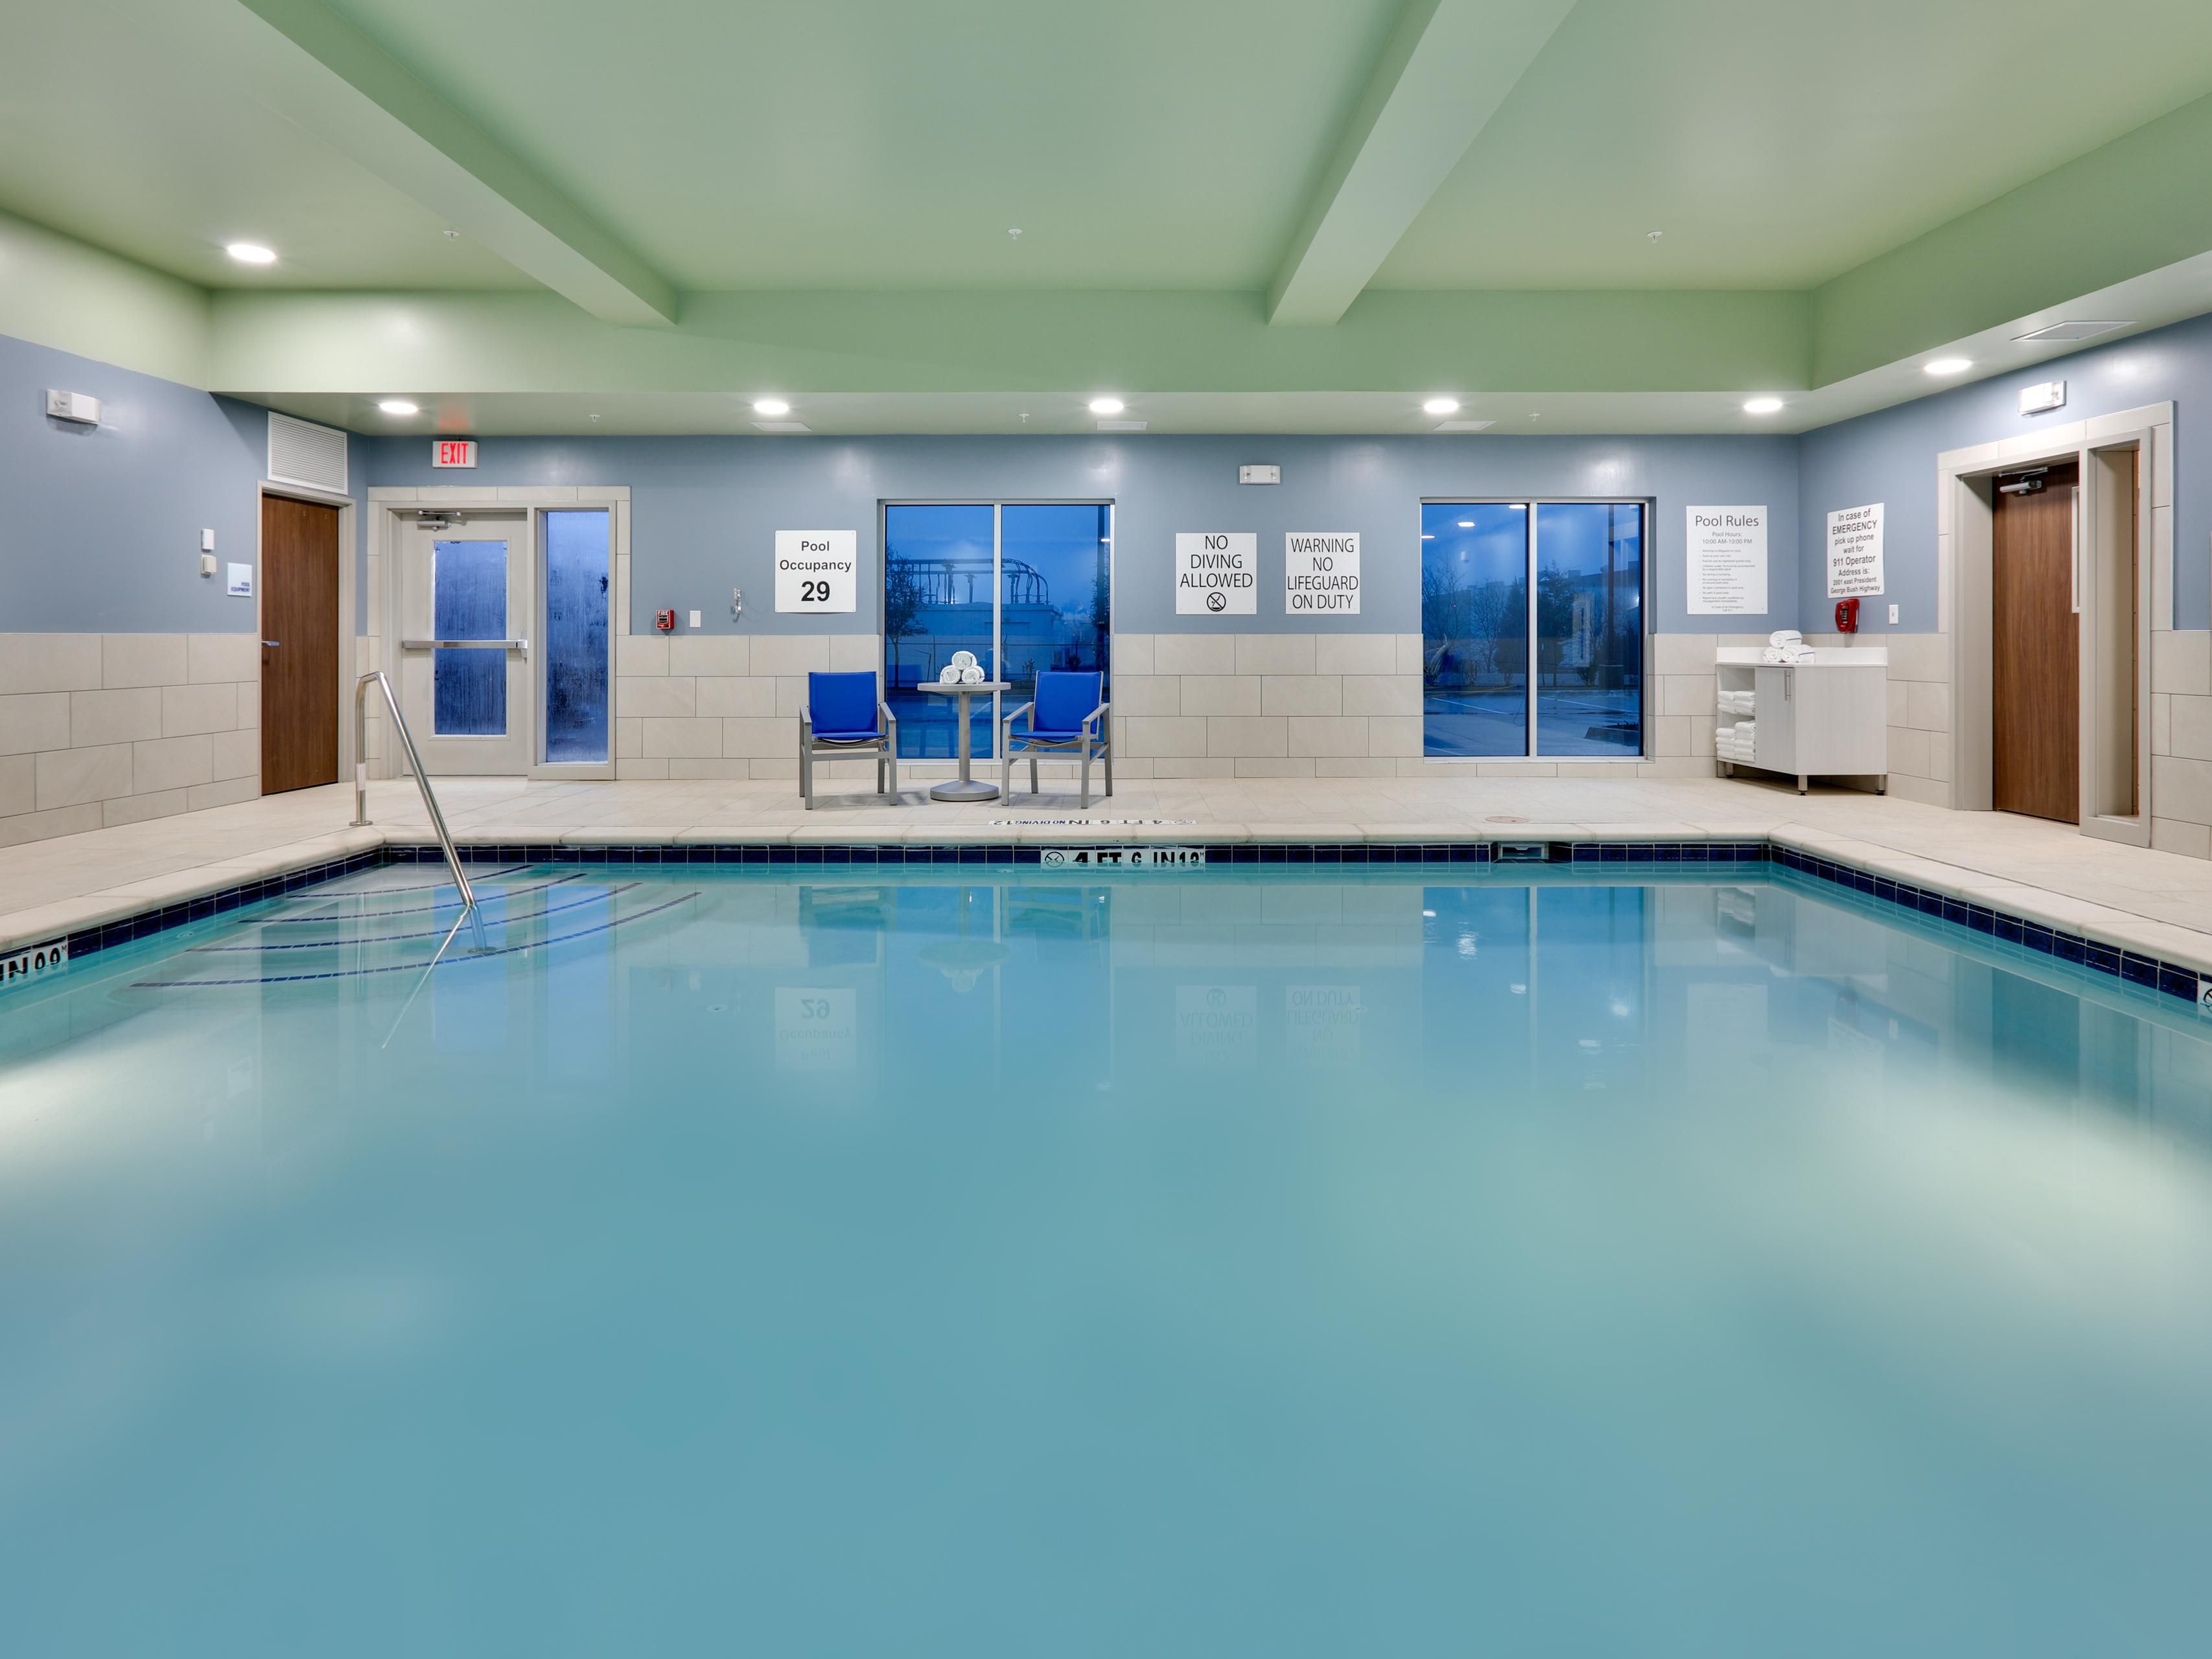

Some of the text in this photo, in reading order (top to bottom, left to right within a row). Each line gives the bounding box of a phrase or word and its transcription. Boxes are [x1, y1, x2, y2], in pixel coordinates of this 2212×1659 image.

[441, 443, 469, 464] EXIT
[1695, 515, 1759, 526] Pool Rules
[1838, 508, 1871, 522] In case of
[1832, 519, 1878, 535] EMERGENCY
[801, 540, 830, 551] Pool
[1205, 535, 1228, 550] NO
[1291, 538, 1354, 553] WARNING
[1835, 537, 1846, 546] pick
[1856, 534, 1874, 544] phone
[780, 559, 852, 573] Occupancy
[1191, 554, 1242, 568] DIVING
[1313, 557, 1333, 572] NO
[1833, 555, 1876, 567] 911 Operator
[1180, 573, 1253, 588] ALLOWED
[1287, 575, 1358, 590] LIFEGUARD
[800, 581, 830, 602] 29
[1292, 594, 1354, 609] ON DUTY
[1074, 852, 1088, 863] 4
[1097, 852, 1122, 863] FT
[1153, 852, 1175, 863] IN
